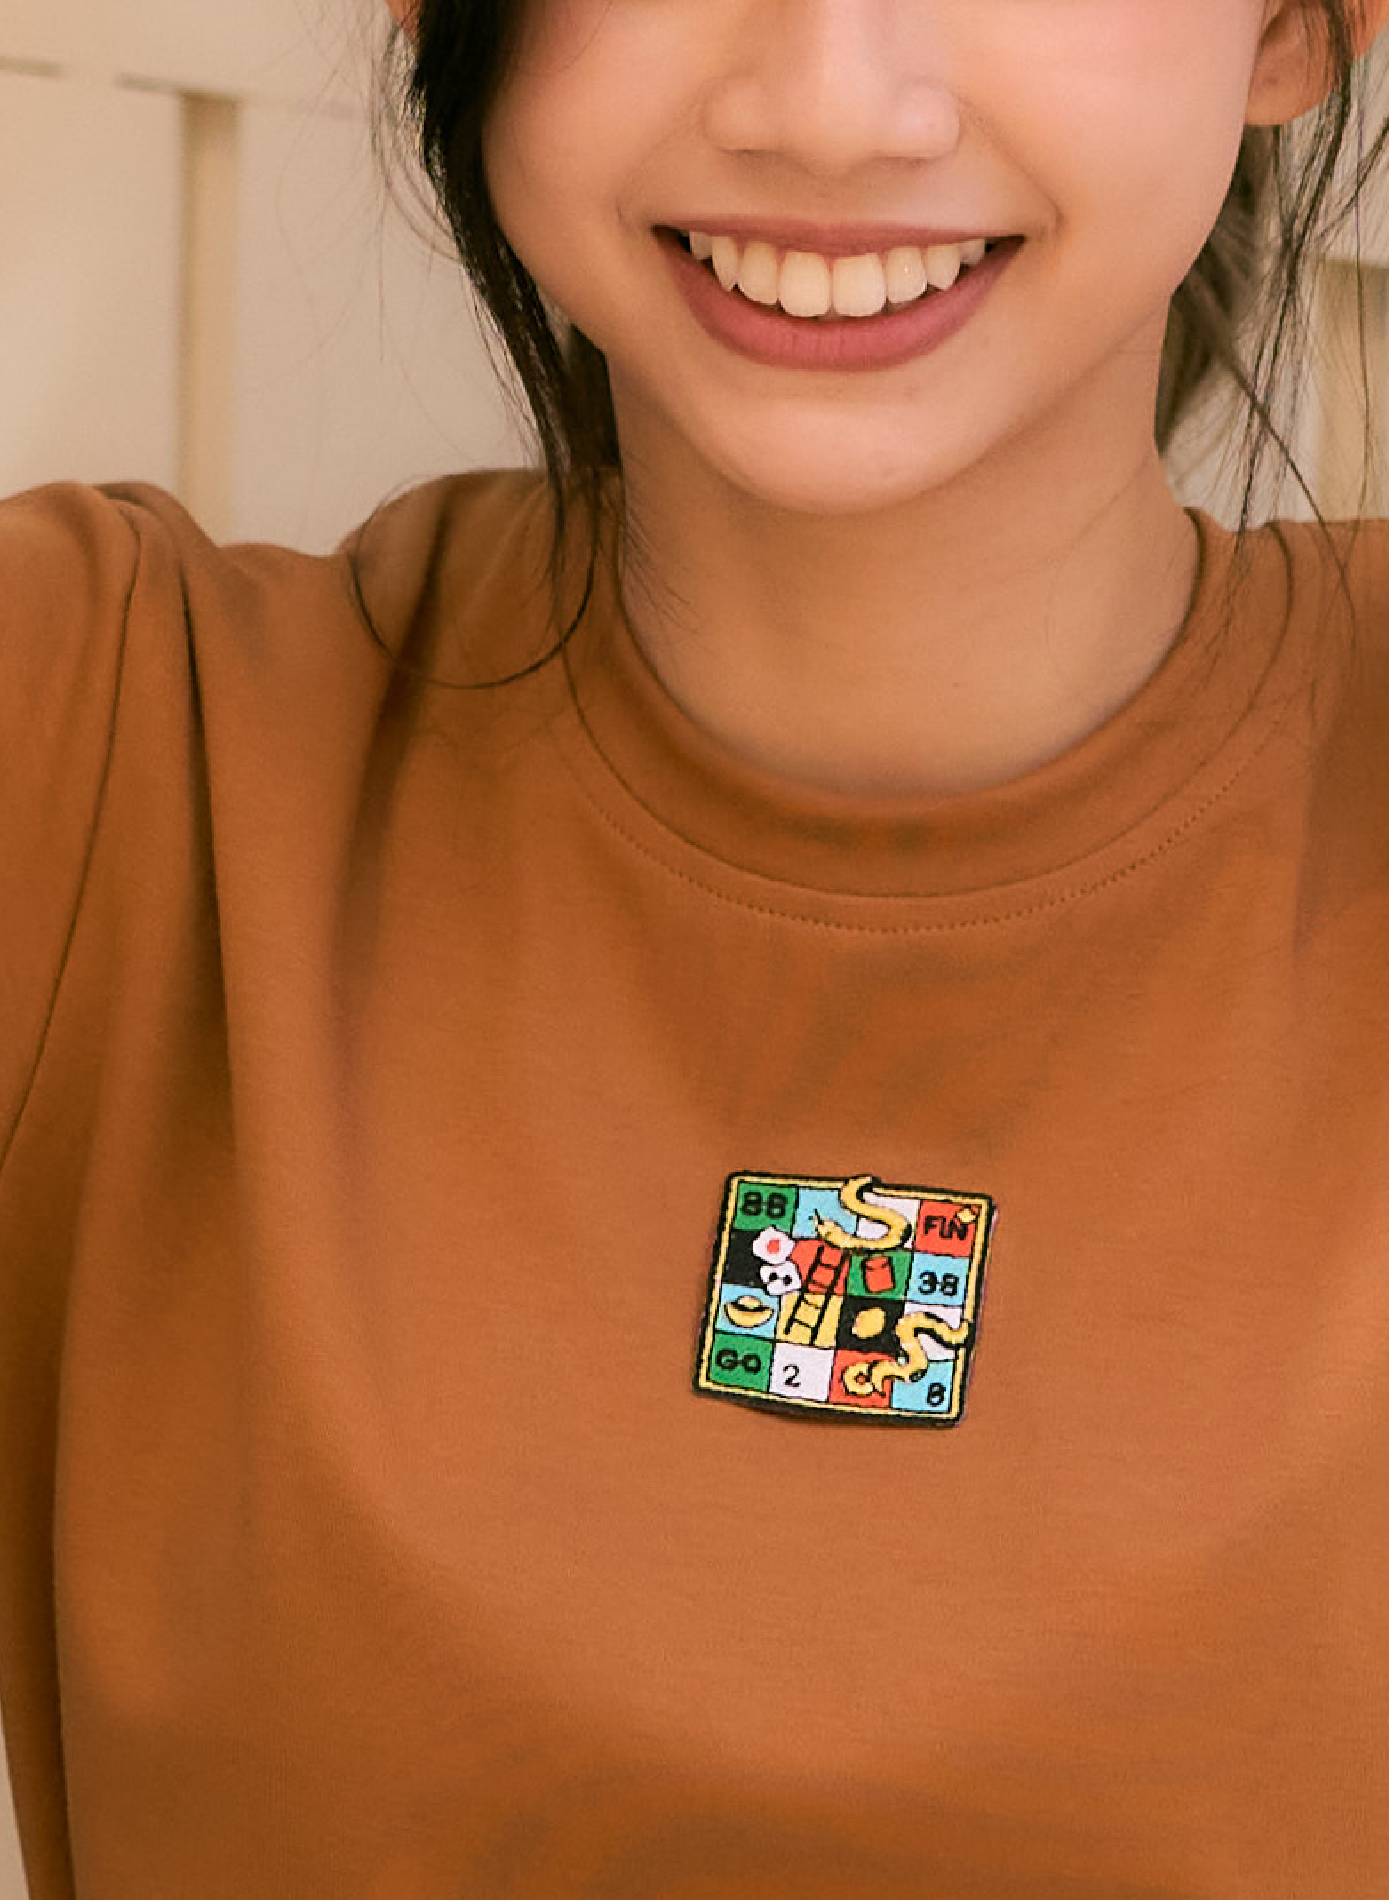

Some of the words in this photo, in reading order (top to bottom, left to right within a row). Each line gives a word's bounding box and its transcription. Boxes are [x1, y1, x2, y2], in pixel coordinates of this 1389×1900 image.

[740, 1191, 788, 1218] 88
[923, 1215, 968, 1242] FIN
[917, 1270, 960, 1297] 38
[715, 1348, 763, 1375] GO
[782, 1364, 803, 1388] 2
[926, 1381, 947, 1408] 8
